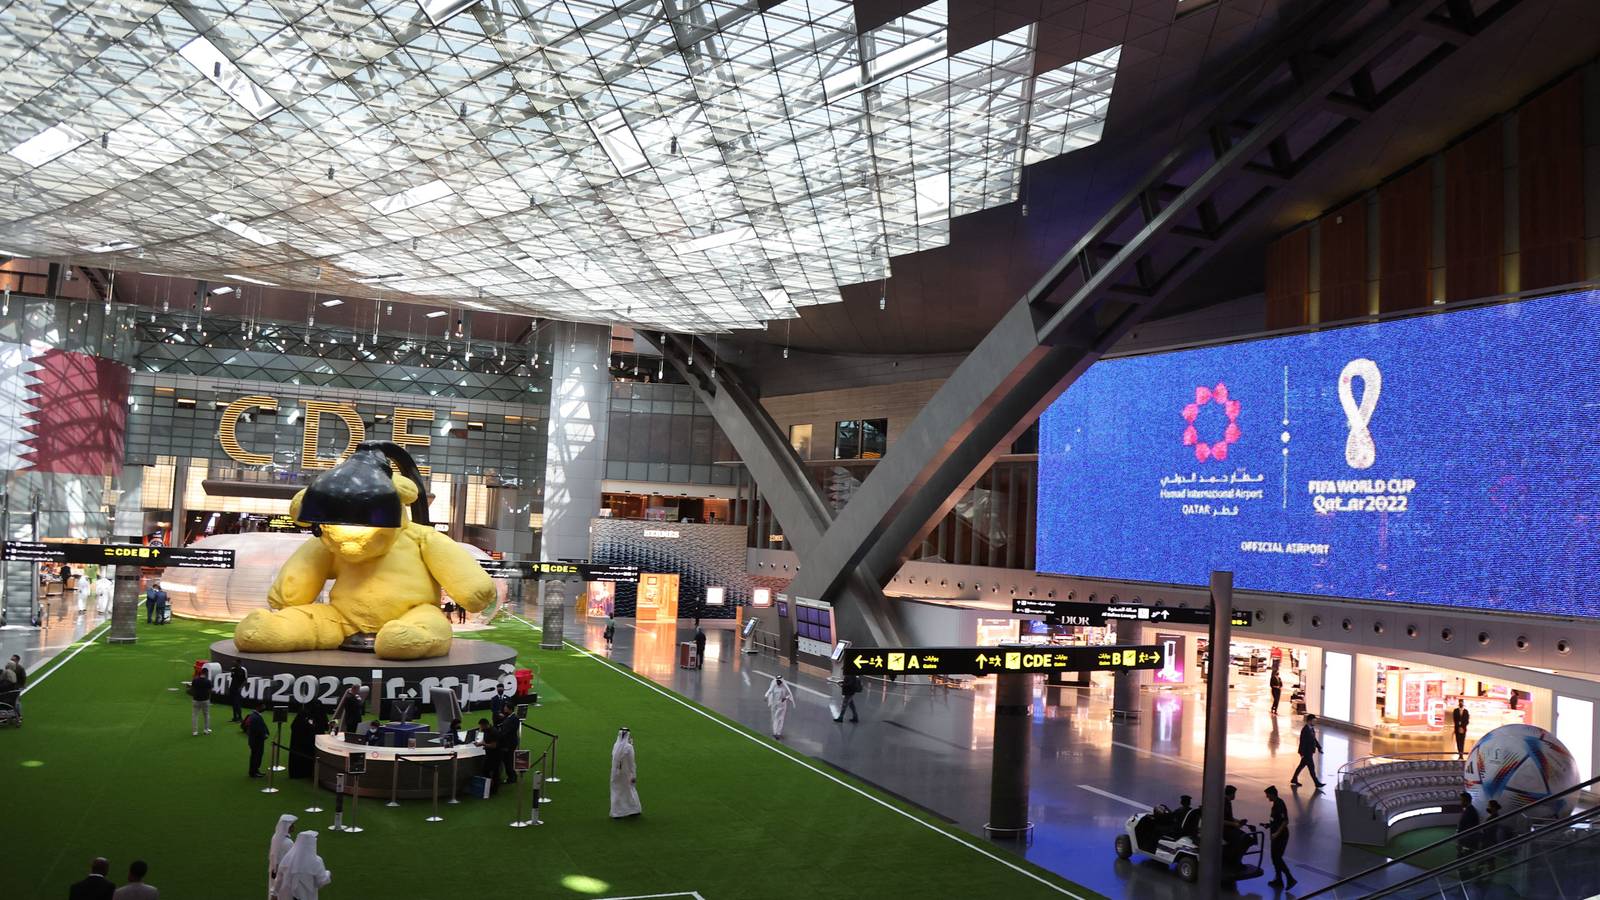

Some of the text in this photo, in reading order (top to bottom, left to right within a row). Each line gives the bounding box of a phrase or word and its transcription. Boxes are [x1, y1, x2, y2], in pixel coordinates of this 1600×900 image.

[1308, 479, 1416, 494] FIFA WORLD CUP
[1160, 489, 1264, 500] Hamad International Airport
[1182, 504, 1211, 515] QATAR
[1213, 505, 1239, 517] قطر
[115, 548, 138, 557] CDE
[1240, 541, 1330, 555] OFFICIAL AIRPORT
[550, 565, 569, 573] CDE
[1061, 615, 1090, 626] DIOR
[907, 655, 920, 669] A
[1023, 653, 1052, 668] CDE
[1112, 652, 1122, 666] B
